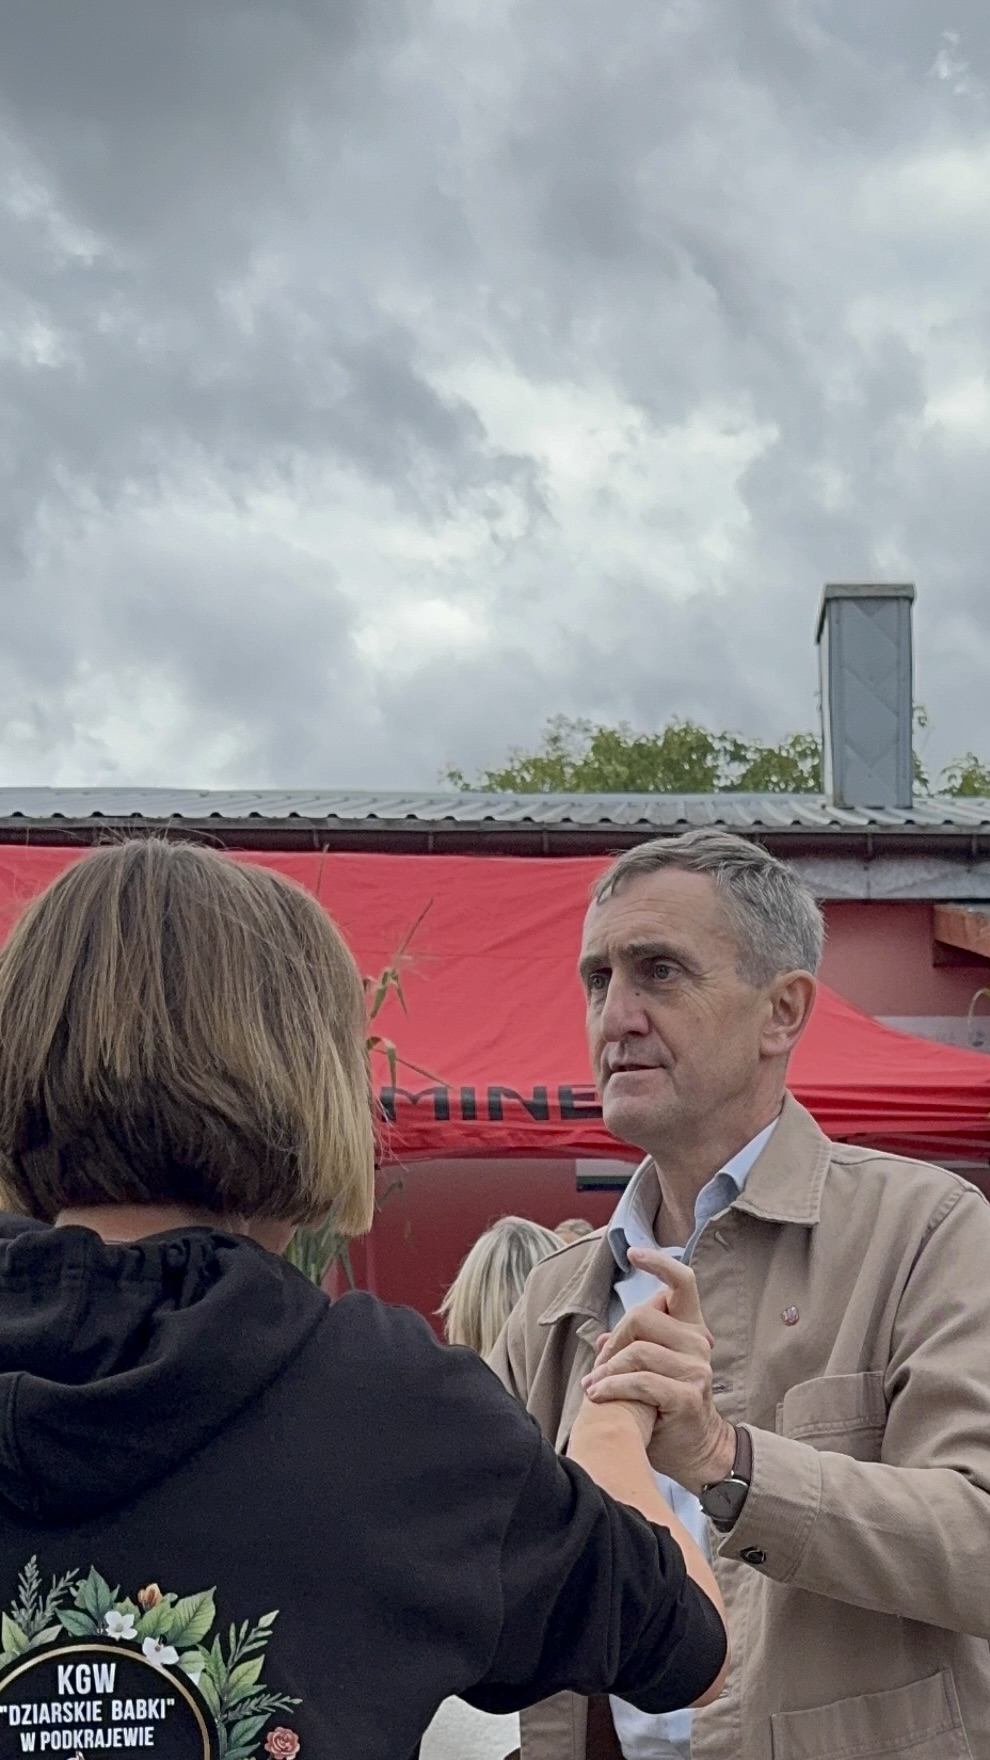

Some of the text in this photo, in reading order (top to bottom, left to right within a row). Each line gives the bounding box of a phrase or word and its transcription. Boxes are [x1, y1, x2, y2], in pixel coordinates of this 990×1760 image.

[57, 1663, 116, 1695] KGW
[0, 1698, 175, 1726] "DZIARSKIE BABKI"
[20, 1727, 155, 1752] W PODKRAJEWIE
